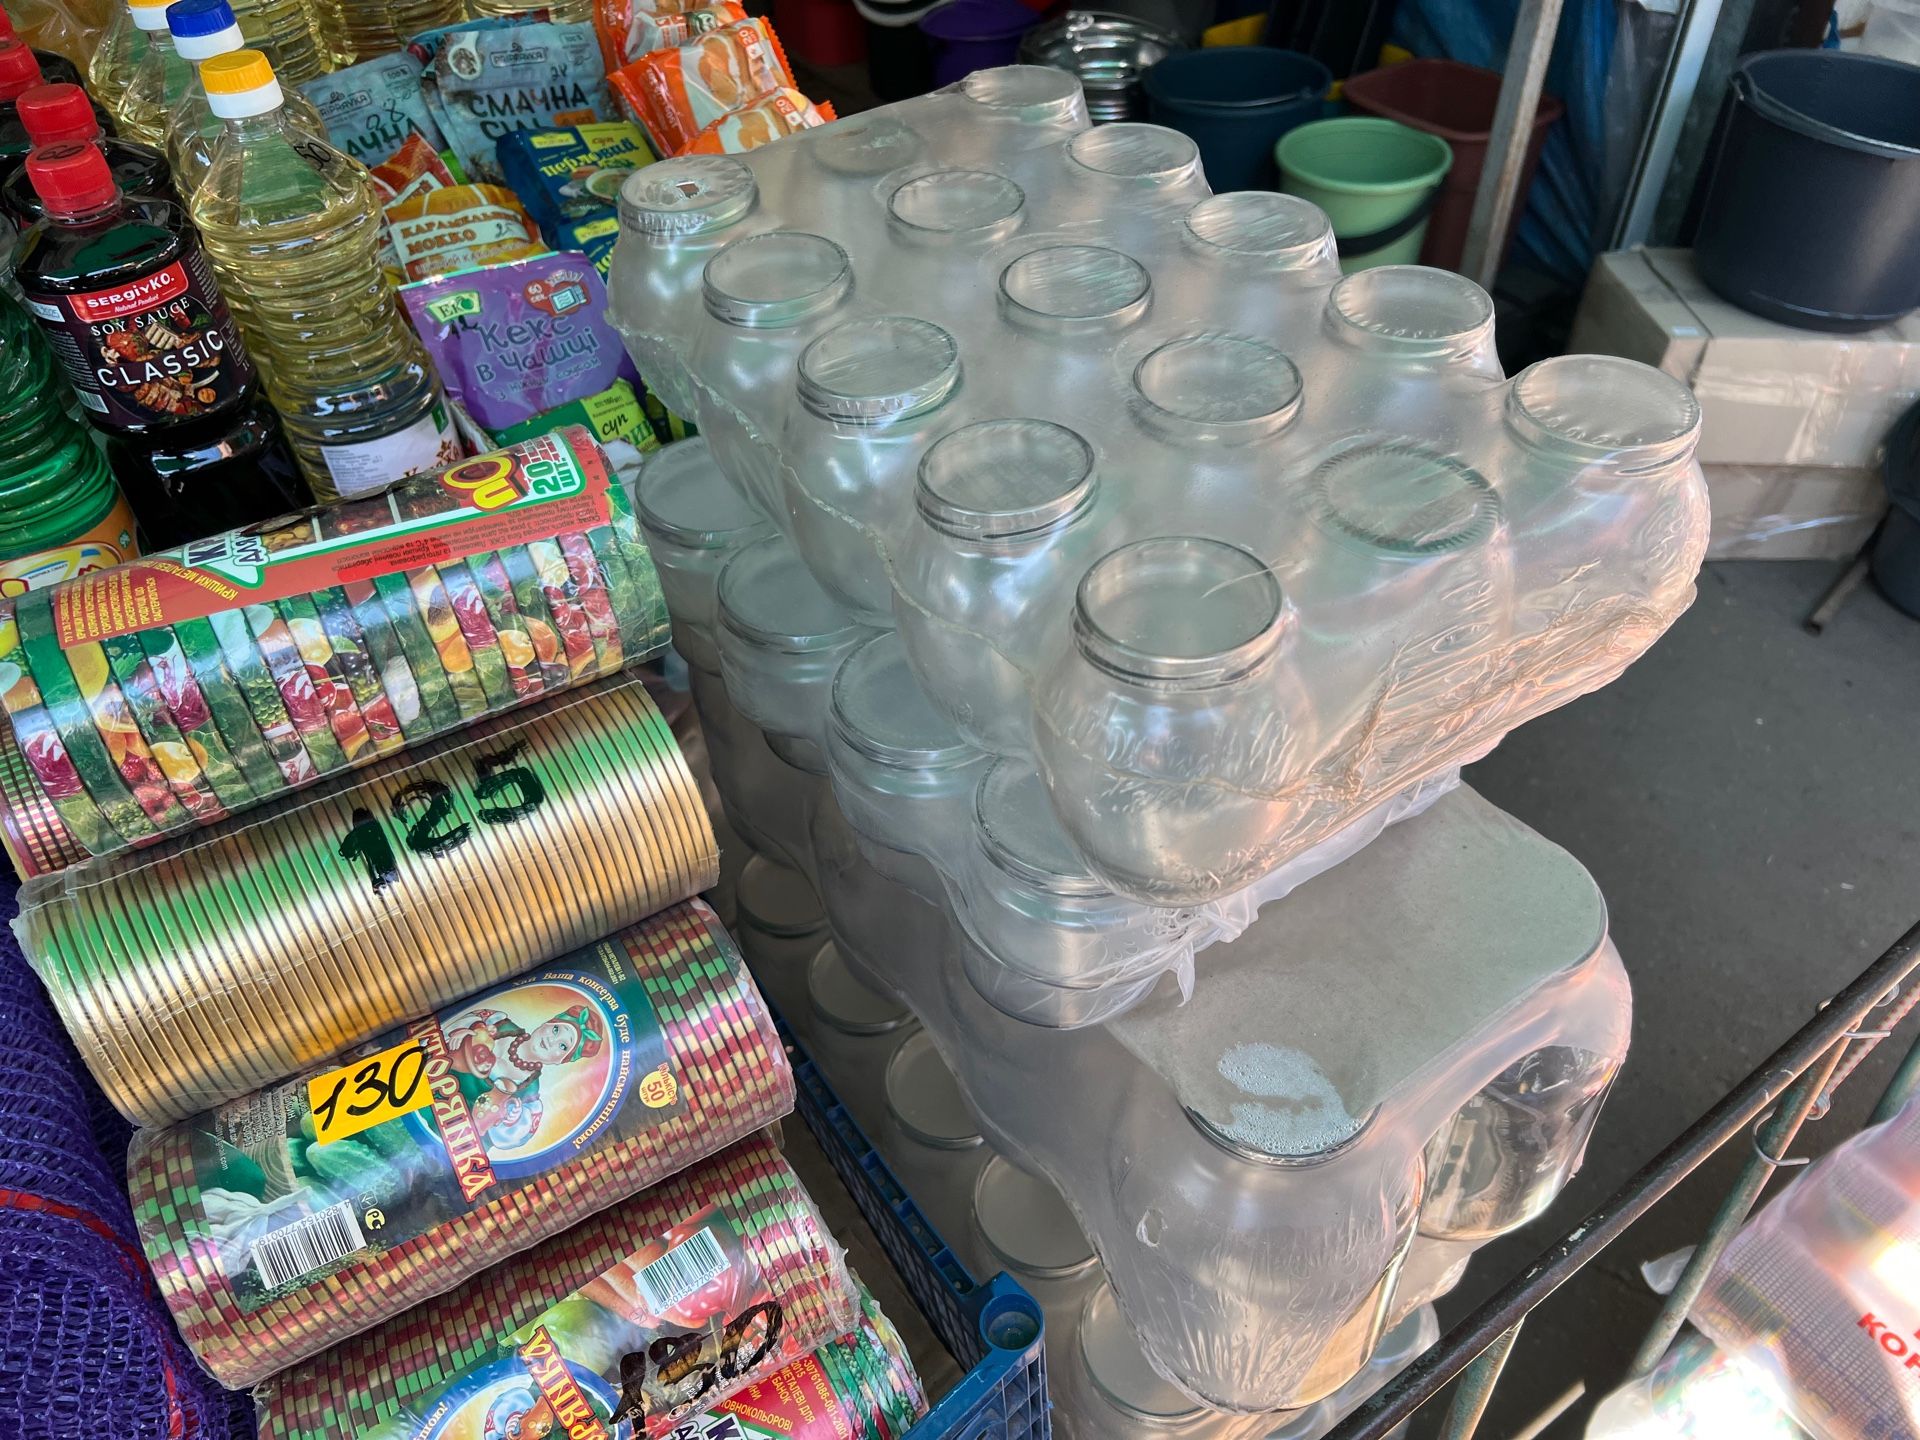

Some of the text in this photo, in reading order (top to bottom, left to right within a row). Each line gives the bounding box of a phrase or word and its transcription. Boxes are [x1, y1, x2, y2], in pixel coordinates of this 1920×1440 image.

[469, 83, 590, 118] СМАЧНА
[406, 229, 478, 256] МОККО
[90, 296, 191, 337] SOY SAUCE
[114, 299, 140, 313] Natural
[97, 330, 224, 387] CLASSIC
[602, 413, 629, 436] суп
[526, 460, 559, 495] 20
[557, 457, 578, 490] ШТ.
[196, 573, 238, 600] КРИШКИ
[338, 739, 545, 898] 125
[542, 971, 575, 981] Ваша
[579, 974, 620, 1012] консерва
[615, 1014, 630, 1044] буде
[313, 1046, 431, 1132] 130
[574, 1049, 630, 1150] найсмачнішою!
[646, 1080, 665, 1103] 50
[300, 1205, 339, 1228] 820154
[257, 1223, 296, 1246] 770019
[662, 1285, 692, 1309] 820154
[694, 1263, 723, 1286] 770019
[790, 1360, 805, 1378] 2015
[771, 1375, 792, 1404] БАНОК
[779, 1365, 816, 1425] МЕТАЛЕВІ ДЛЯ
